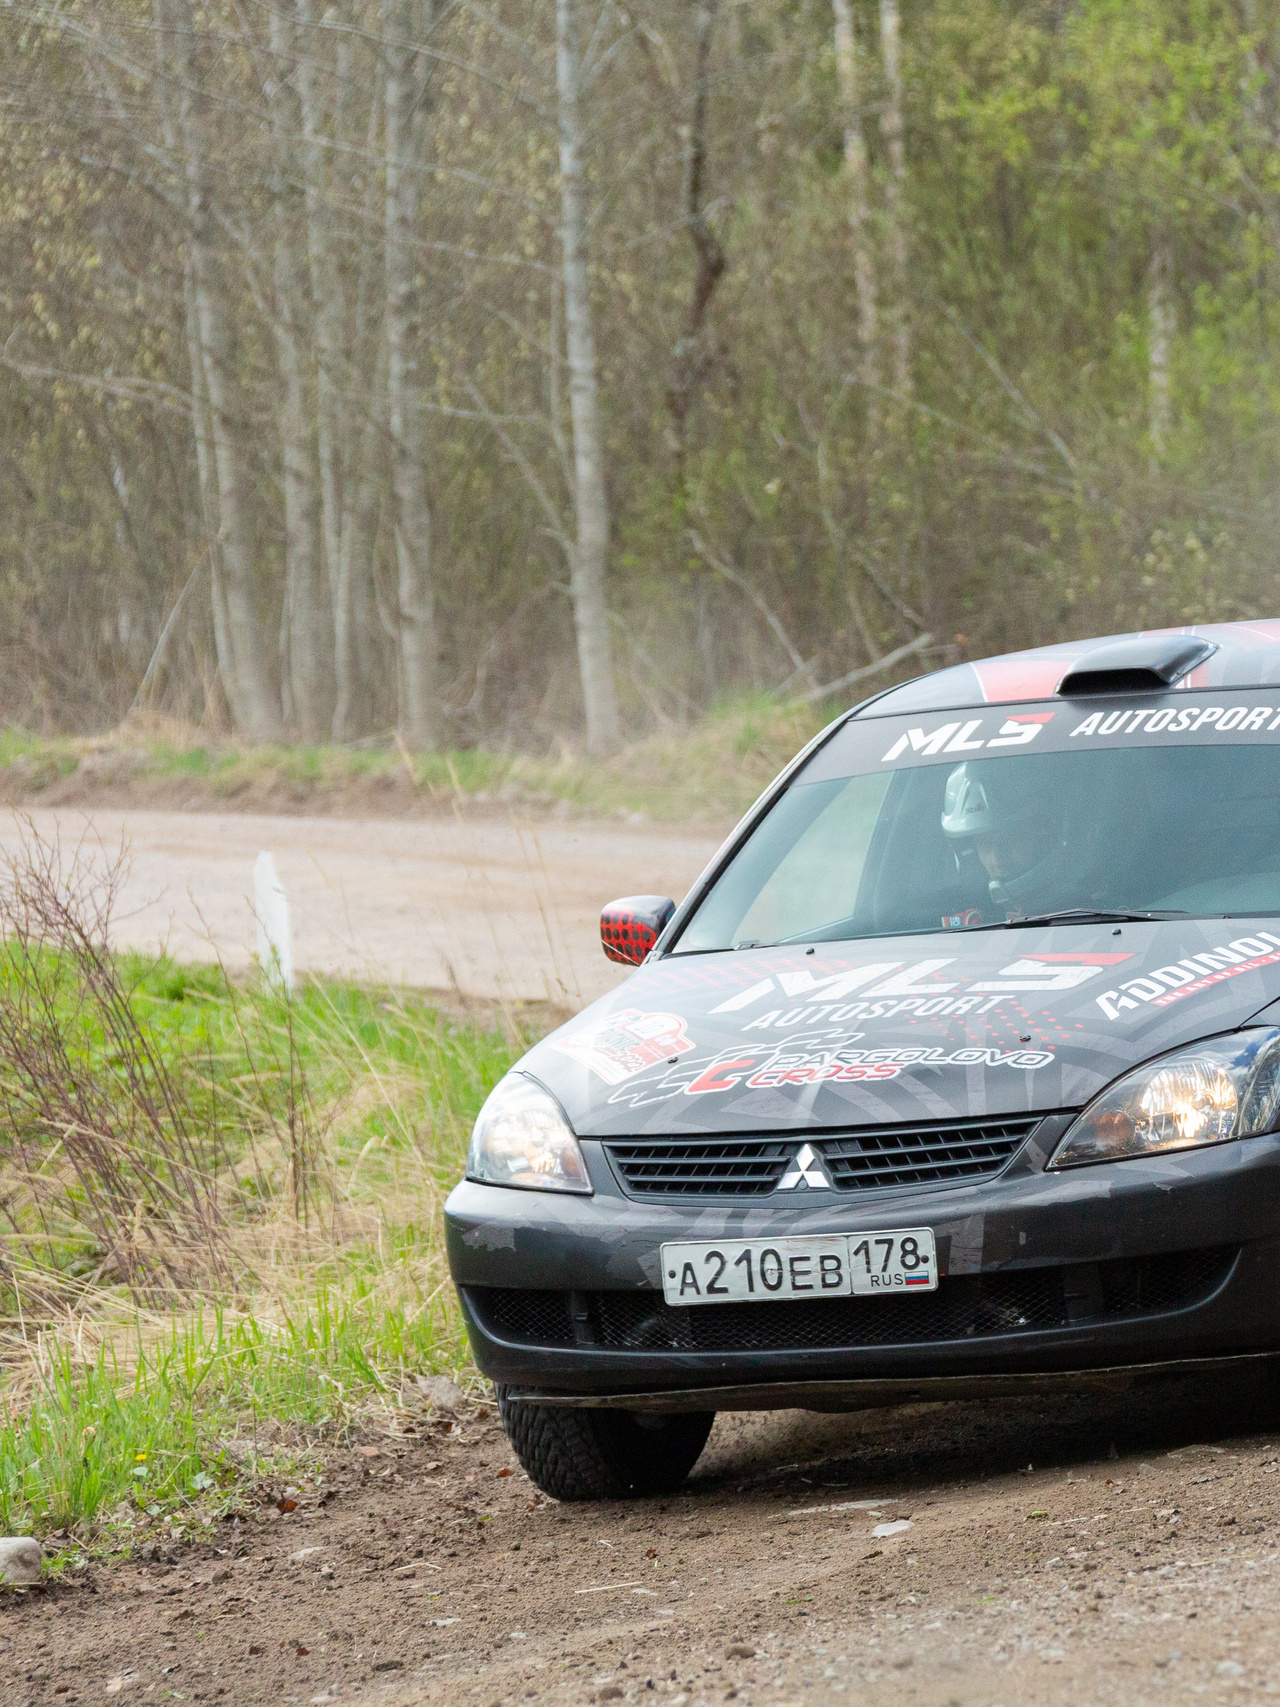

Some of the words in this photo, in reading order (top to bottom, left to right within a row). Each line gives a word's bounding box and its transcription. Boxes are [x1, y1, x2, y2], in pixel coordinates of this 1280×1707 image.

[881, 711, 1056, 762] MLS
[1233, 962, 1260, 972] OIL
[707, 953, 1137, 1015] MLS
[741, 994, 1016, 1032] AUTOSPORT
[765, 1048, 1055, 1069] PARGOLOVO
[746, 1063, 904, 1090] CROSS
[852, 1237, 920, 1273] 178
[870, 1273, 904, 1288] RUS
